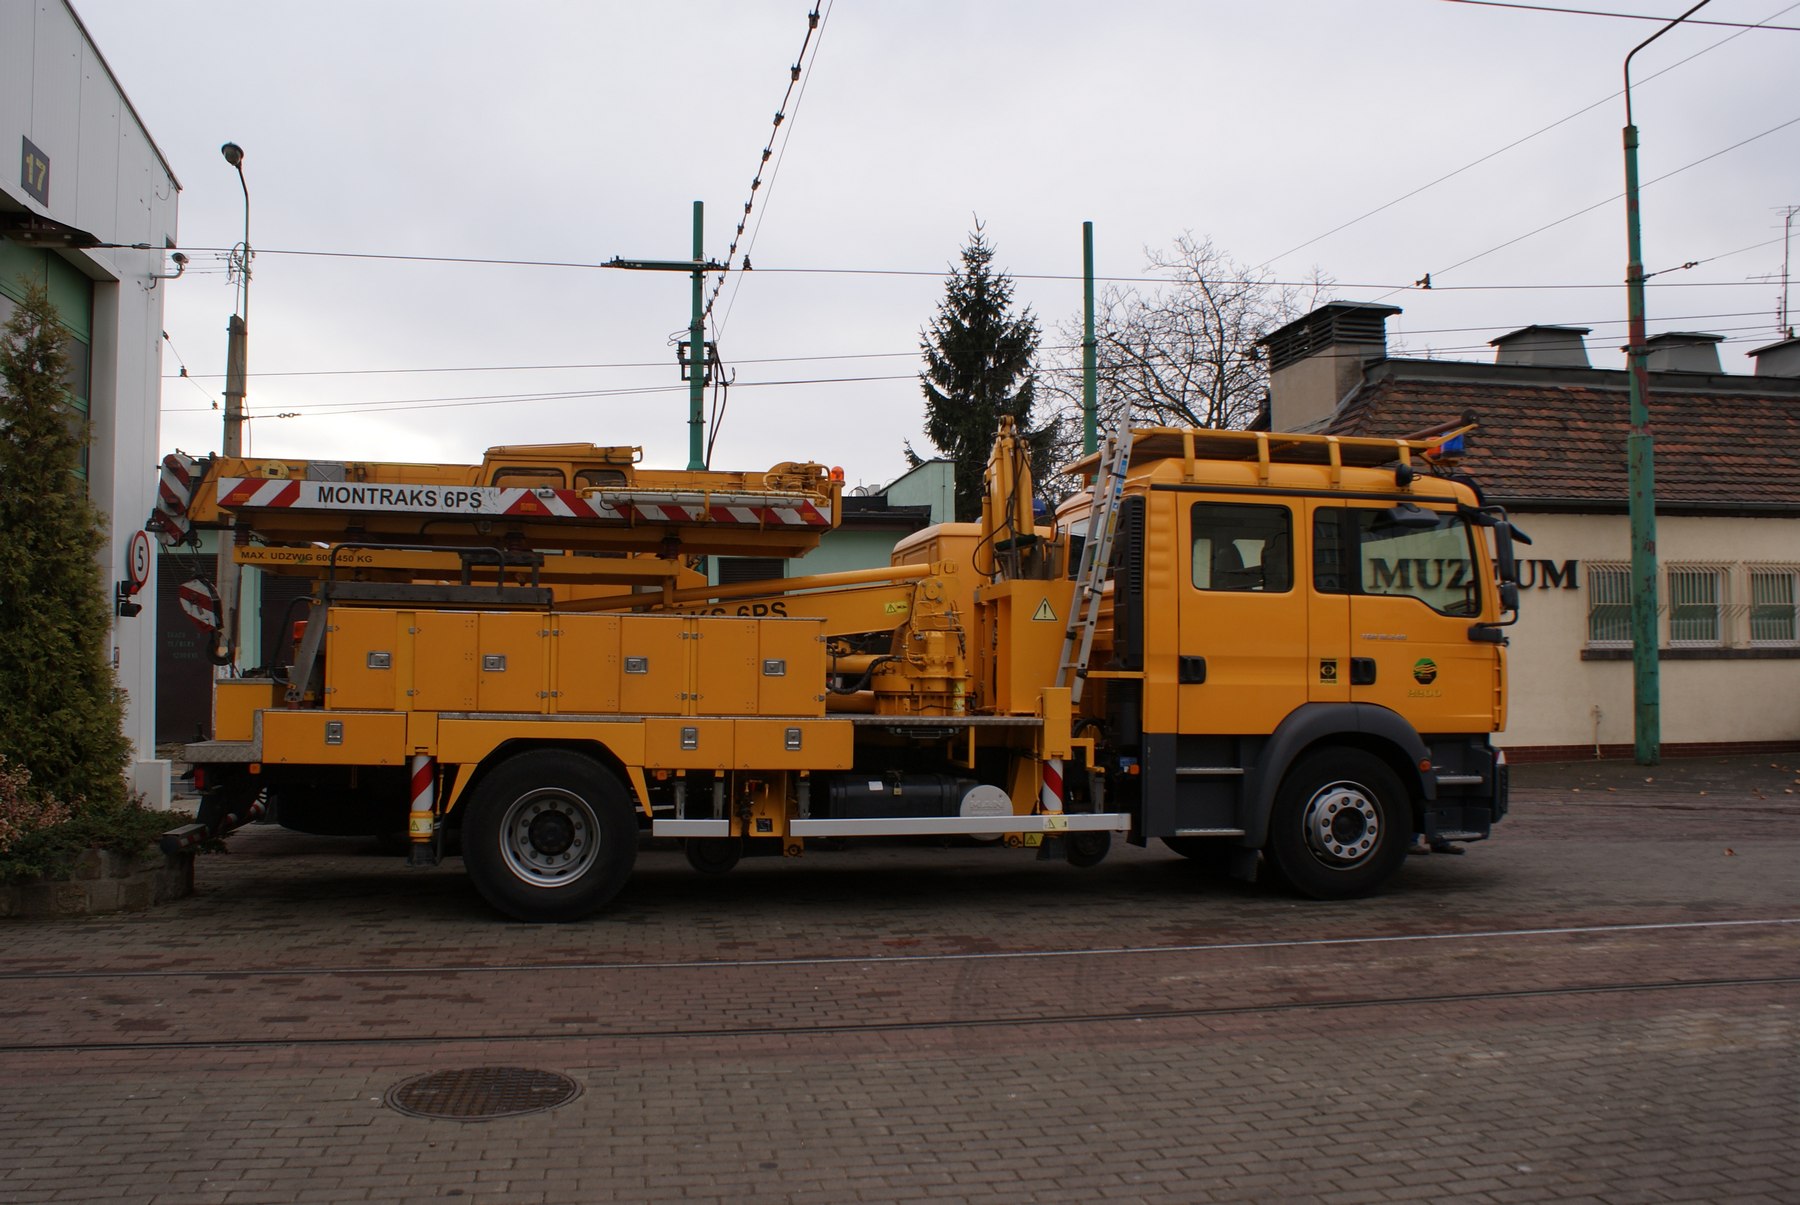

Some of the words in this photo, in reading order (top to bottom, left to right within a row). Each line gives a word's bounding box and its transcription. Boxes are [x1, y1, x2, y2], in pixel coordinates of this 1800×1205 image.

[26, 153, 46, 191] 17
[317, 486, 438, 507] MONTRAKS
[444, 491, 482, 509] 6PS
[137, 545, 144, 572] 5
[270, 552, 314, 561] UDZWIG
[316, 554, 354, 562] 600450
[356, 555, 373, 563] KG
[1368, 558, 1580, 589] MUZUM
